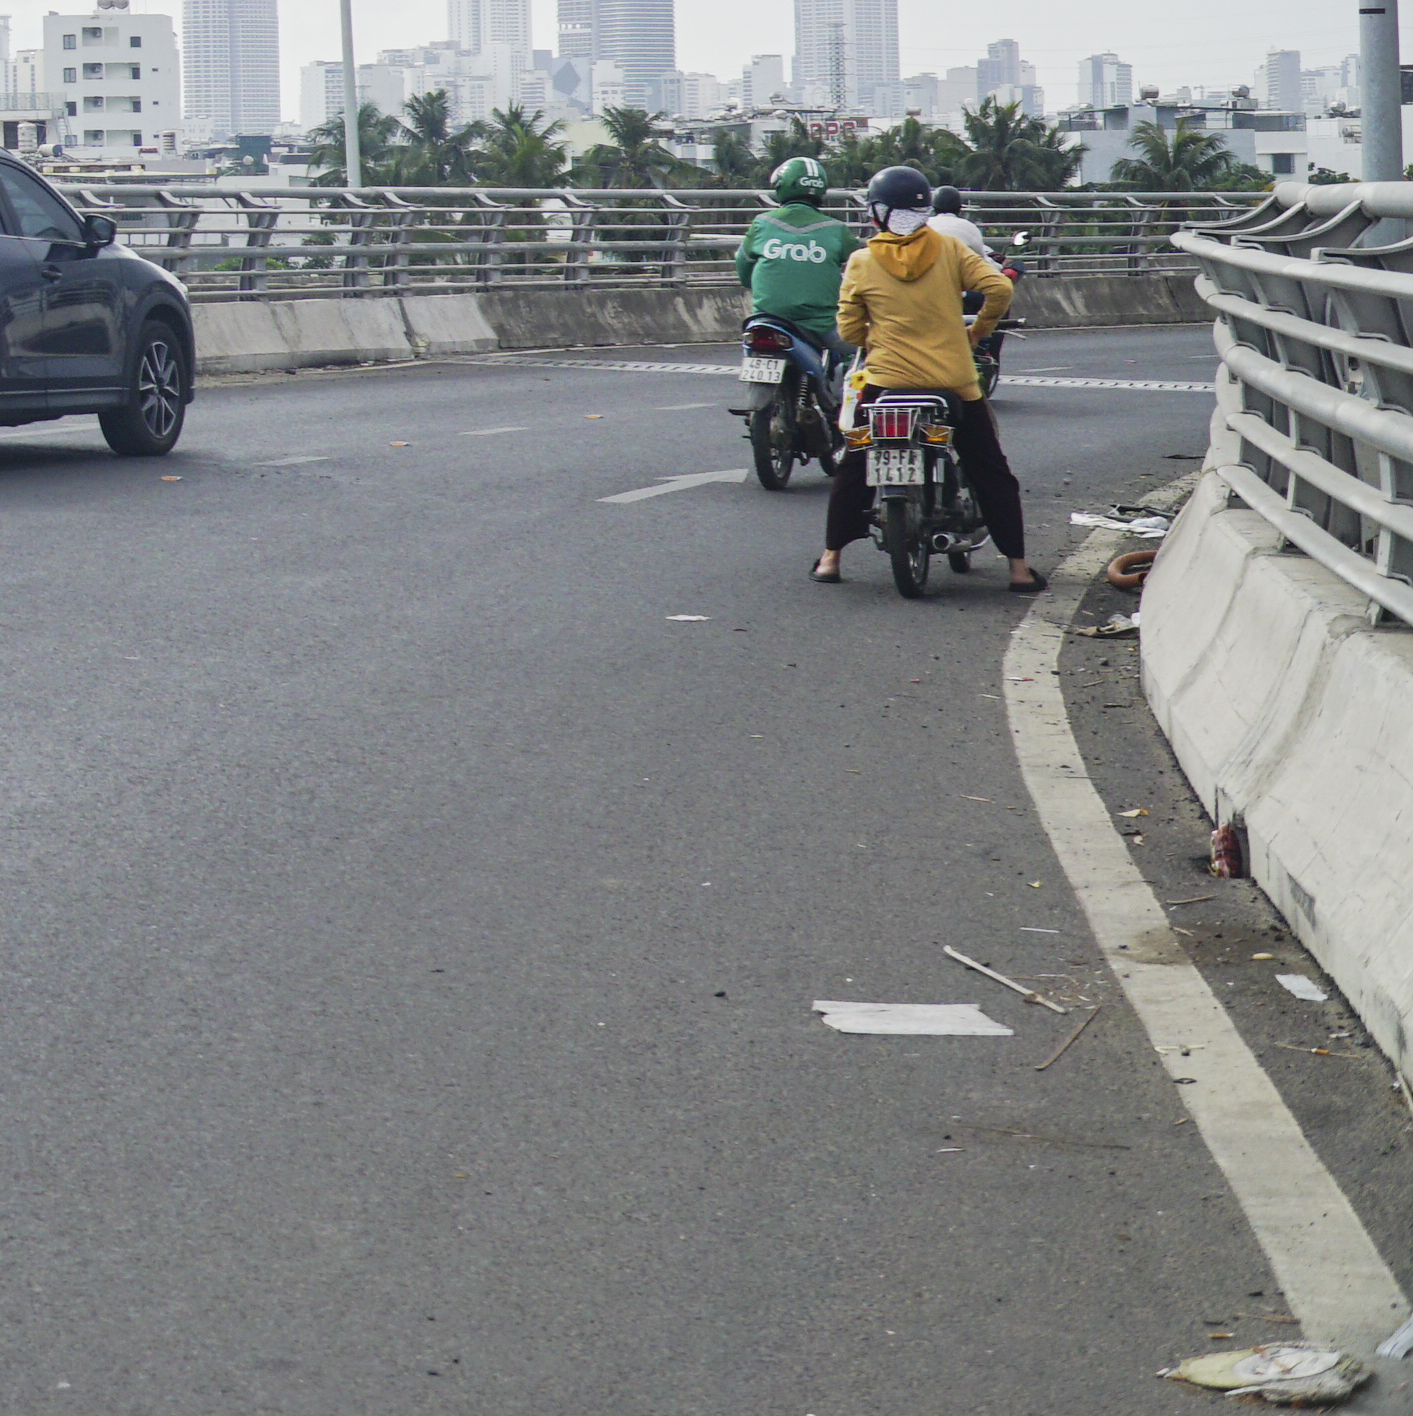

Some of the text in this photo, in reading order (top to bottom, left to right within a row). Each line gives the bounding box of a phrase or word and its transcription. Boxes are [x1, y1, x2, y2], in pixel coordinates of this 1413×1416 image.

[799, 176, 825, 188] Grab
[763, 238, 827, 264] Grab
[874, 466, 917, 483] 1412
